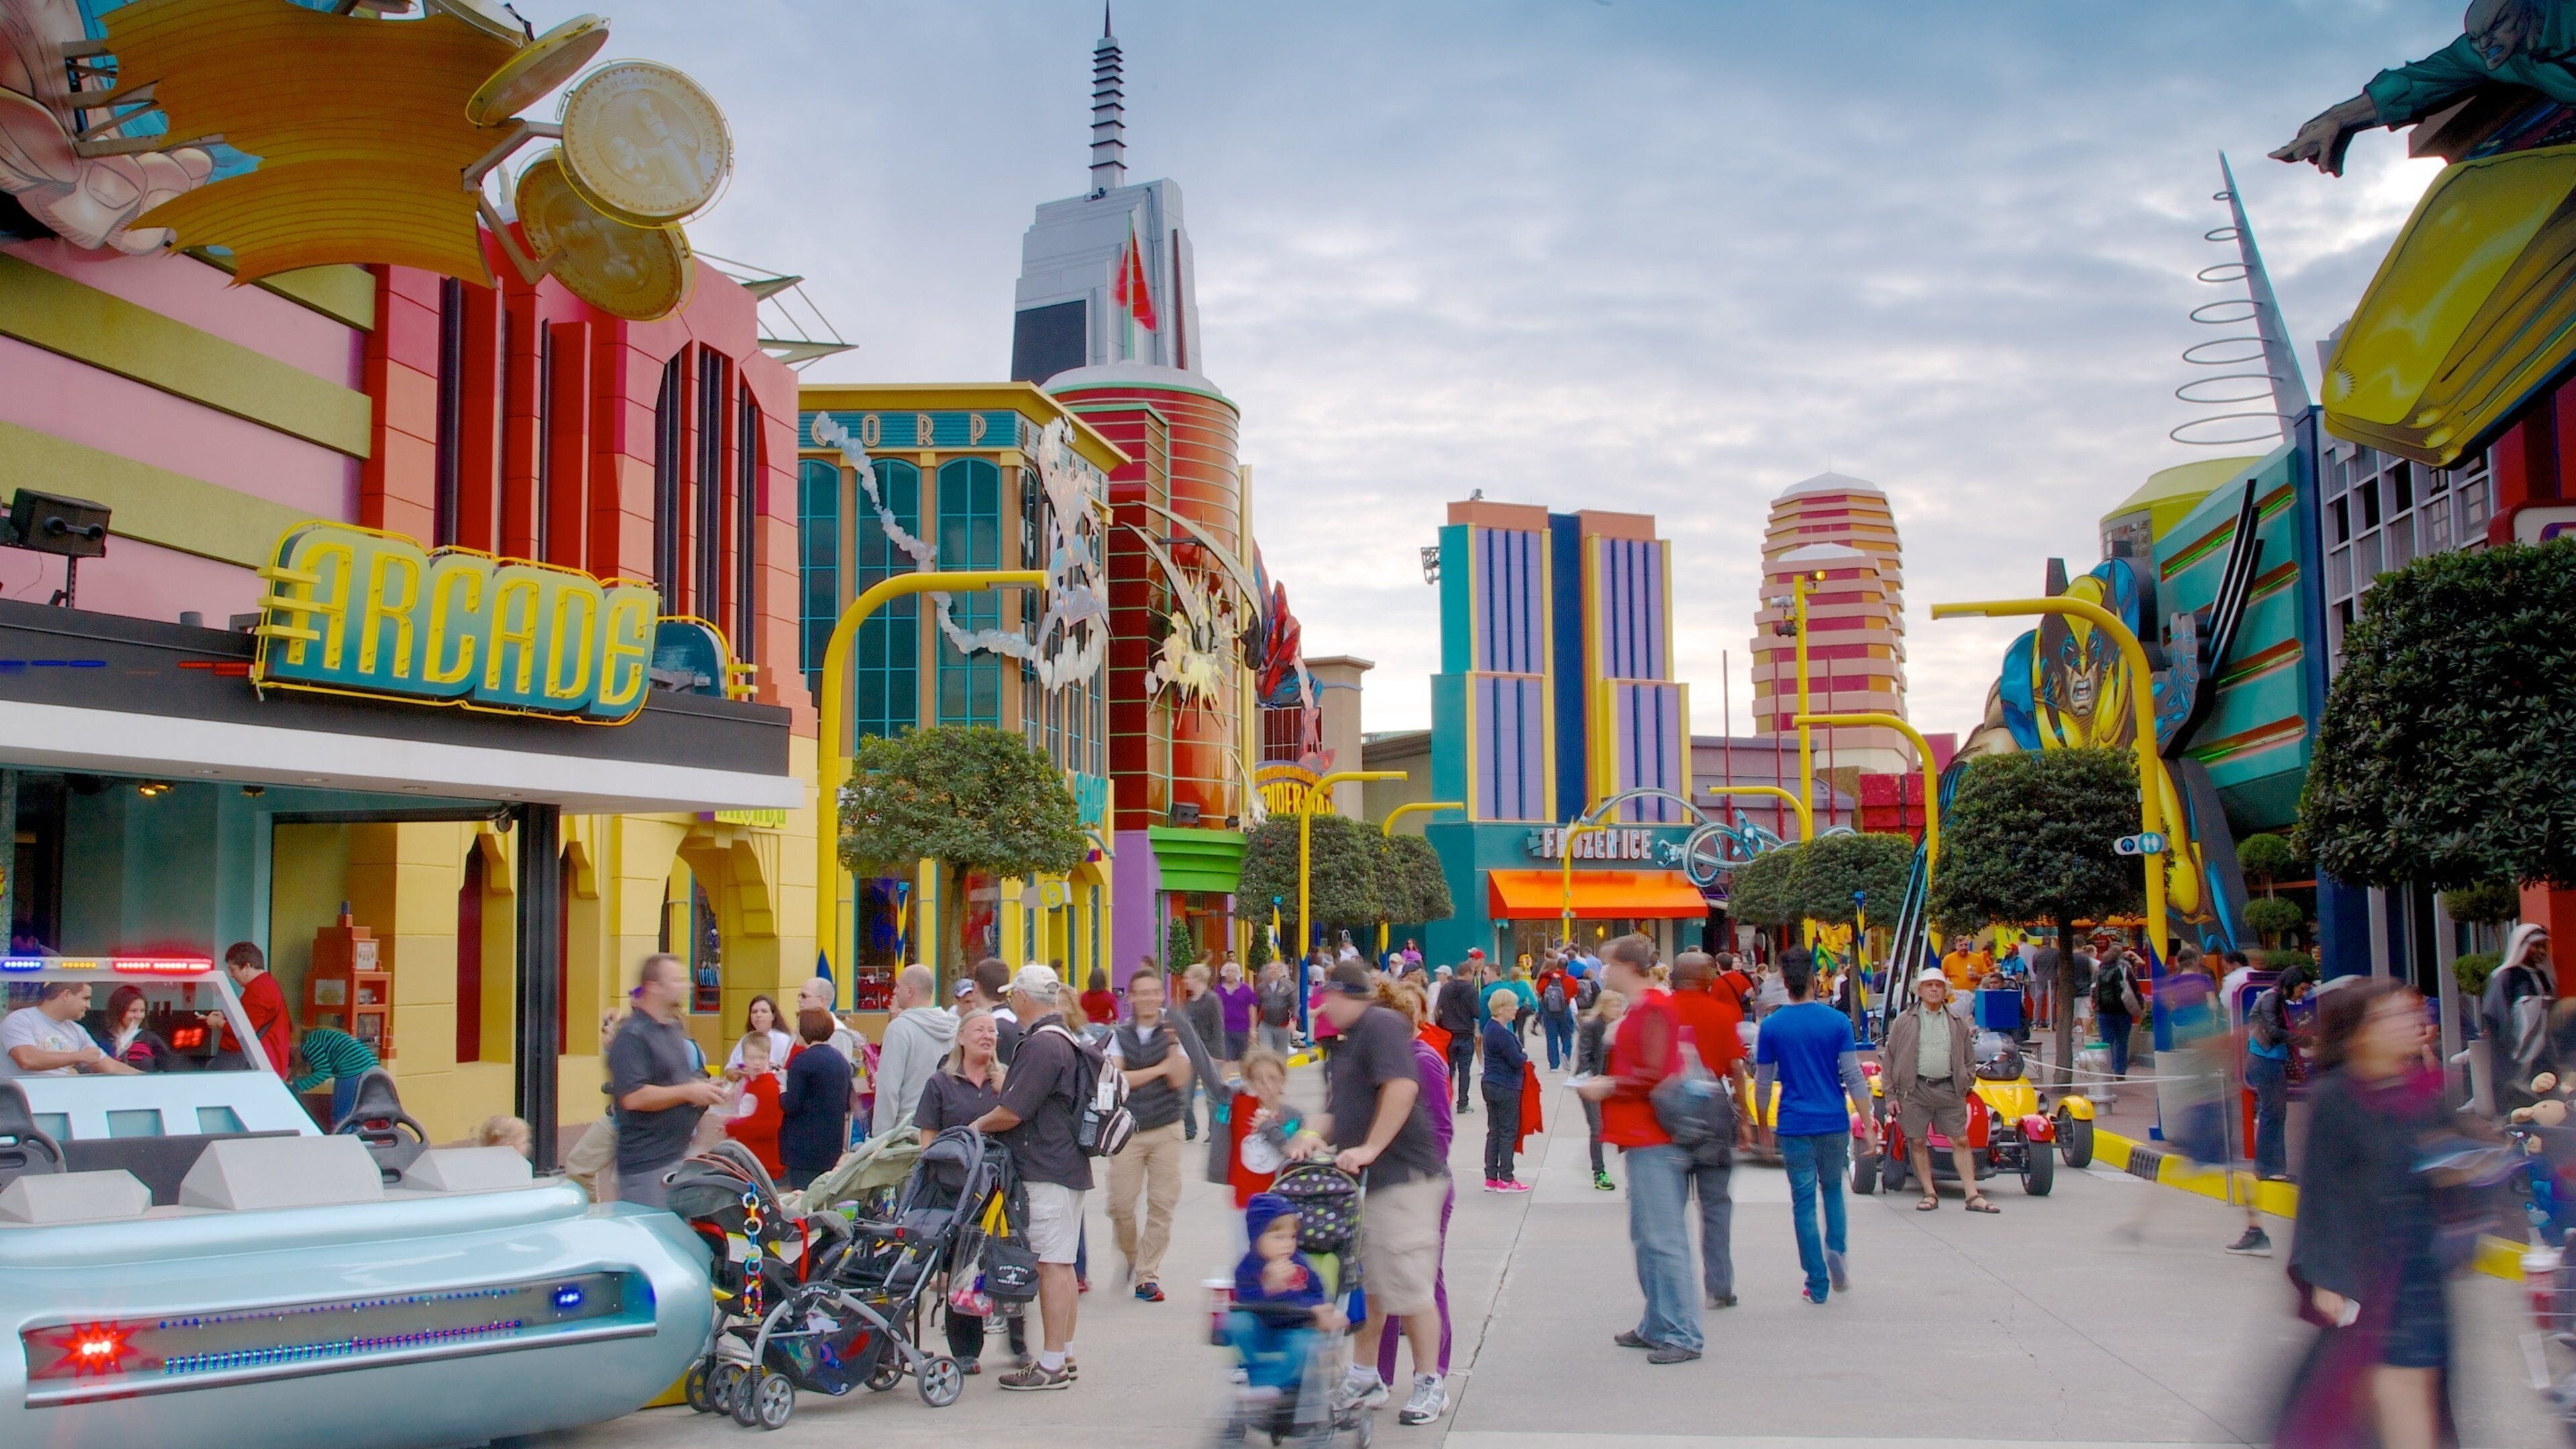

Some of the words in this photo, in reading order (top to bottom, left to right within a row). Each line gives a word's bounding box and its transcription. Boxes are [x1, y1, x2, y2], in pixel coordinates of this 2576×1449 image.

[258, 542, 649, 705] ARCADE
[1075, 771, 1107, 829] SHOP
[1543, 828, 1618, 859] FROZEN
[1621, 828, 1652, 860] ICE
